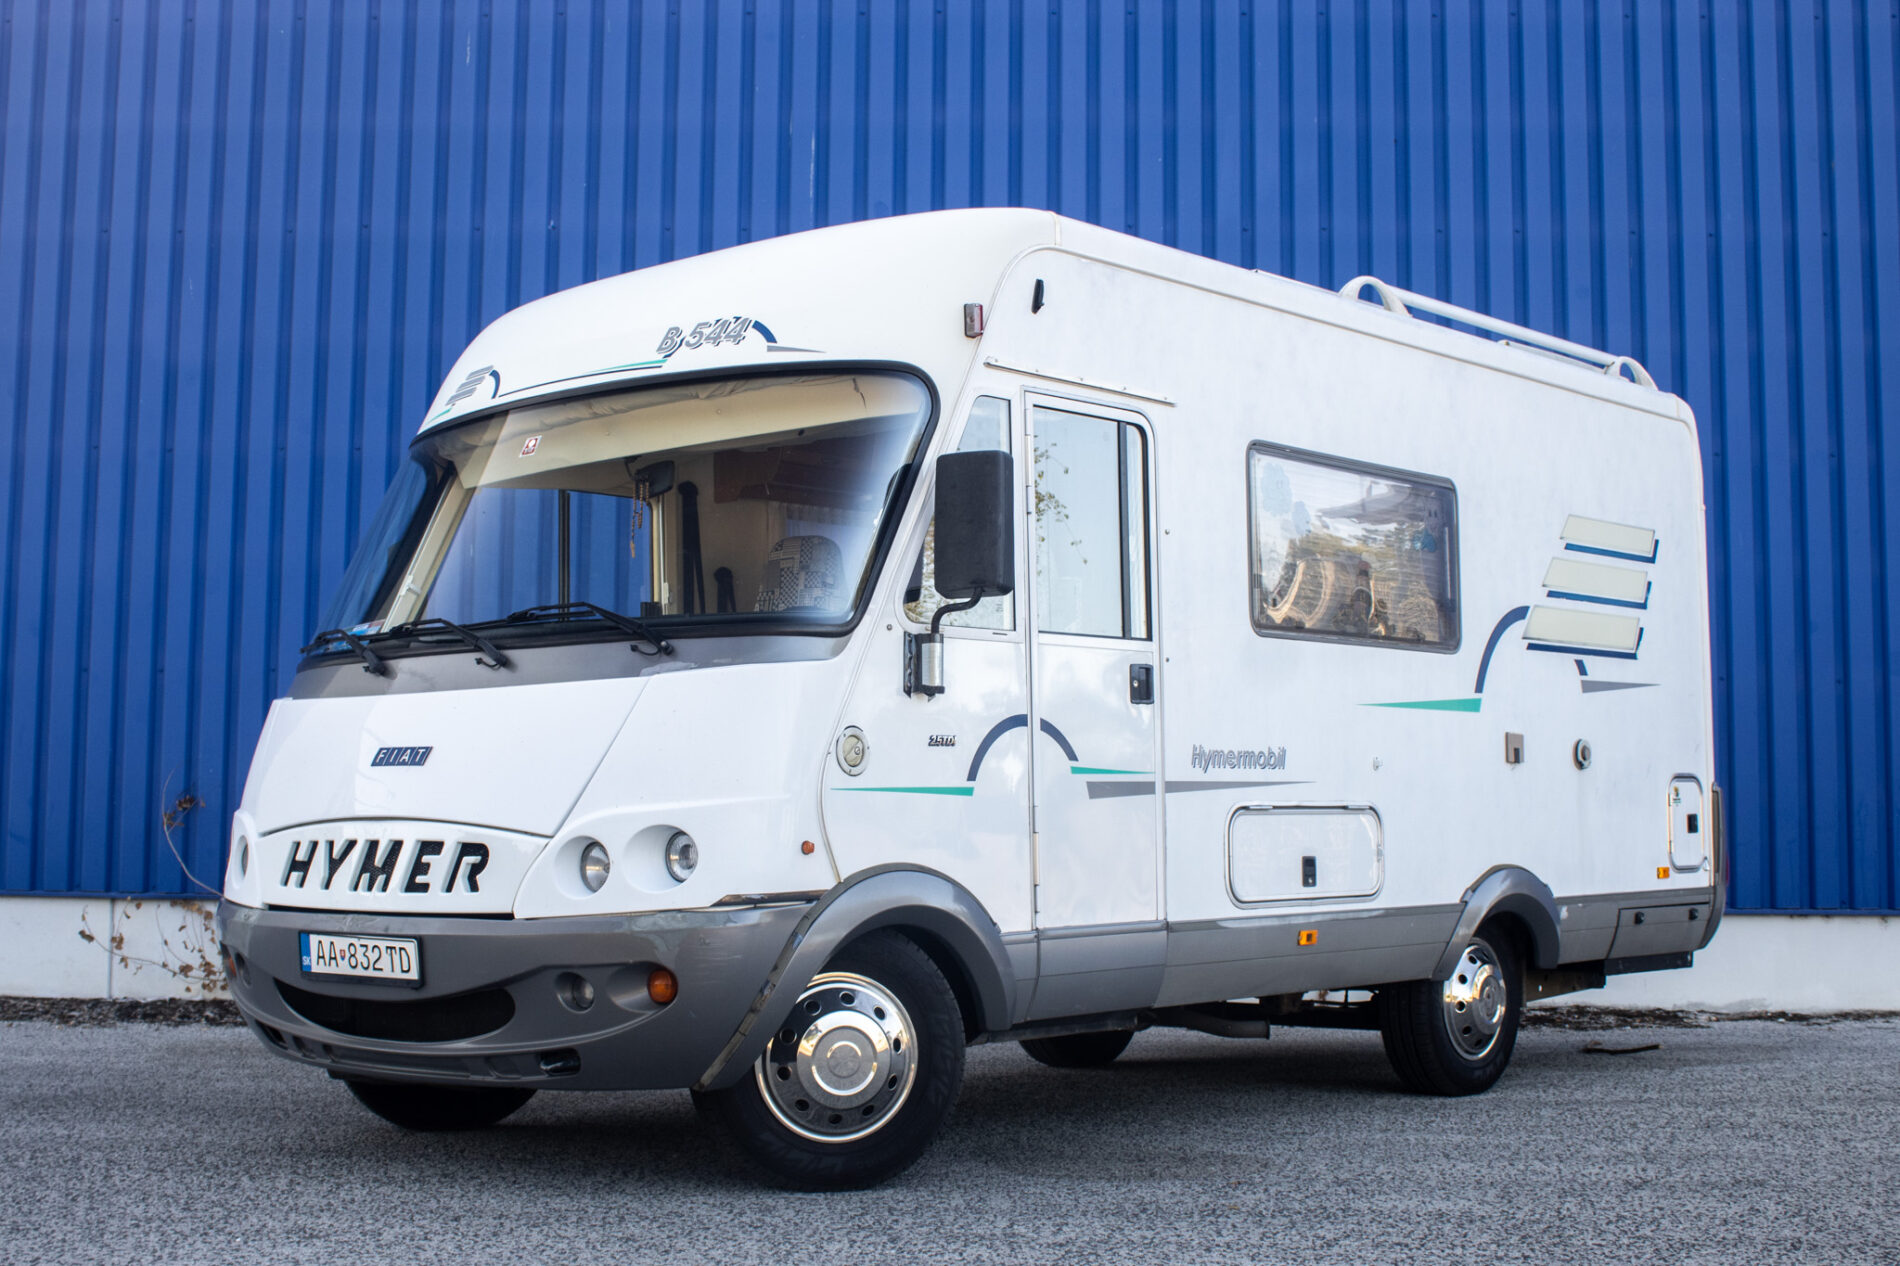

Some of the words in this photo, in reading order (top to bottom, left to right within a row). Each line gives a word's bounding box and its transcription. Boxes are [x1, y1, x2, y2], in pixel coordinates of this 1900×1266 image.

[656, 326, 683, 353] B
[684, 317, 752, 349] 544
[375, 749, 427, 763] FIAT
[1191, 743, 1287, 774] Hymermobil
[280, 839, 491, 893] HYMER
[302, 955, 311, 966] SK
